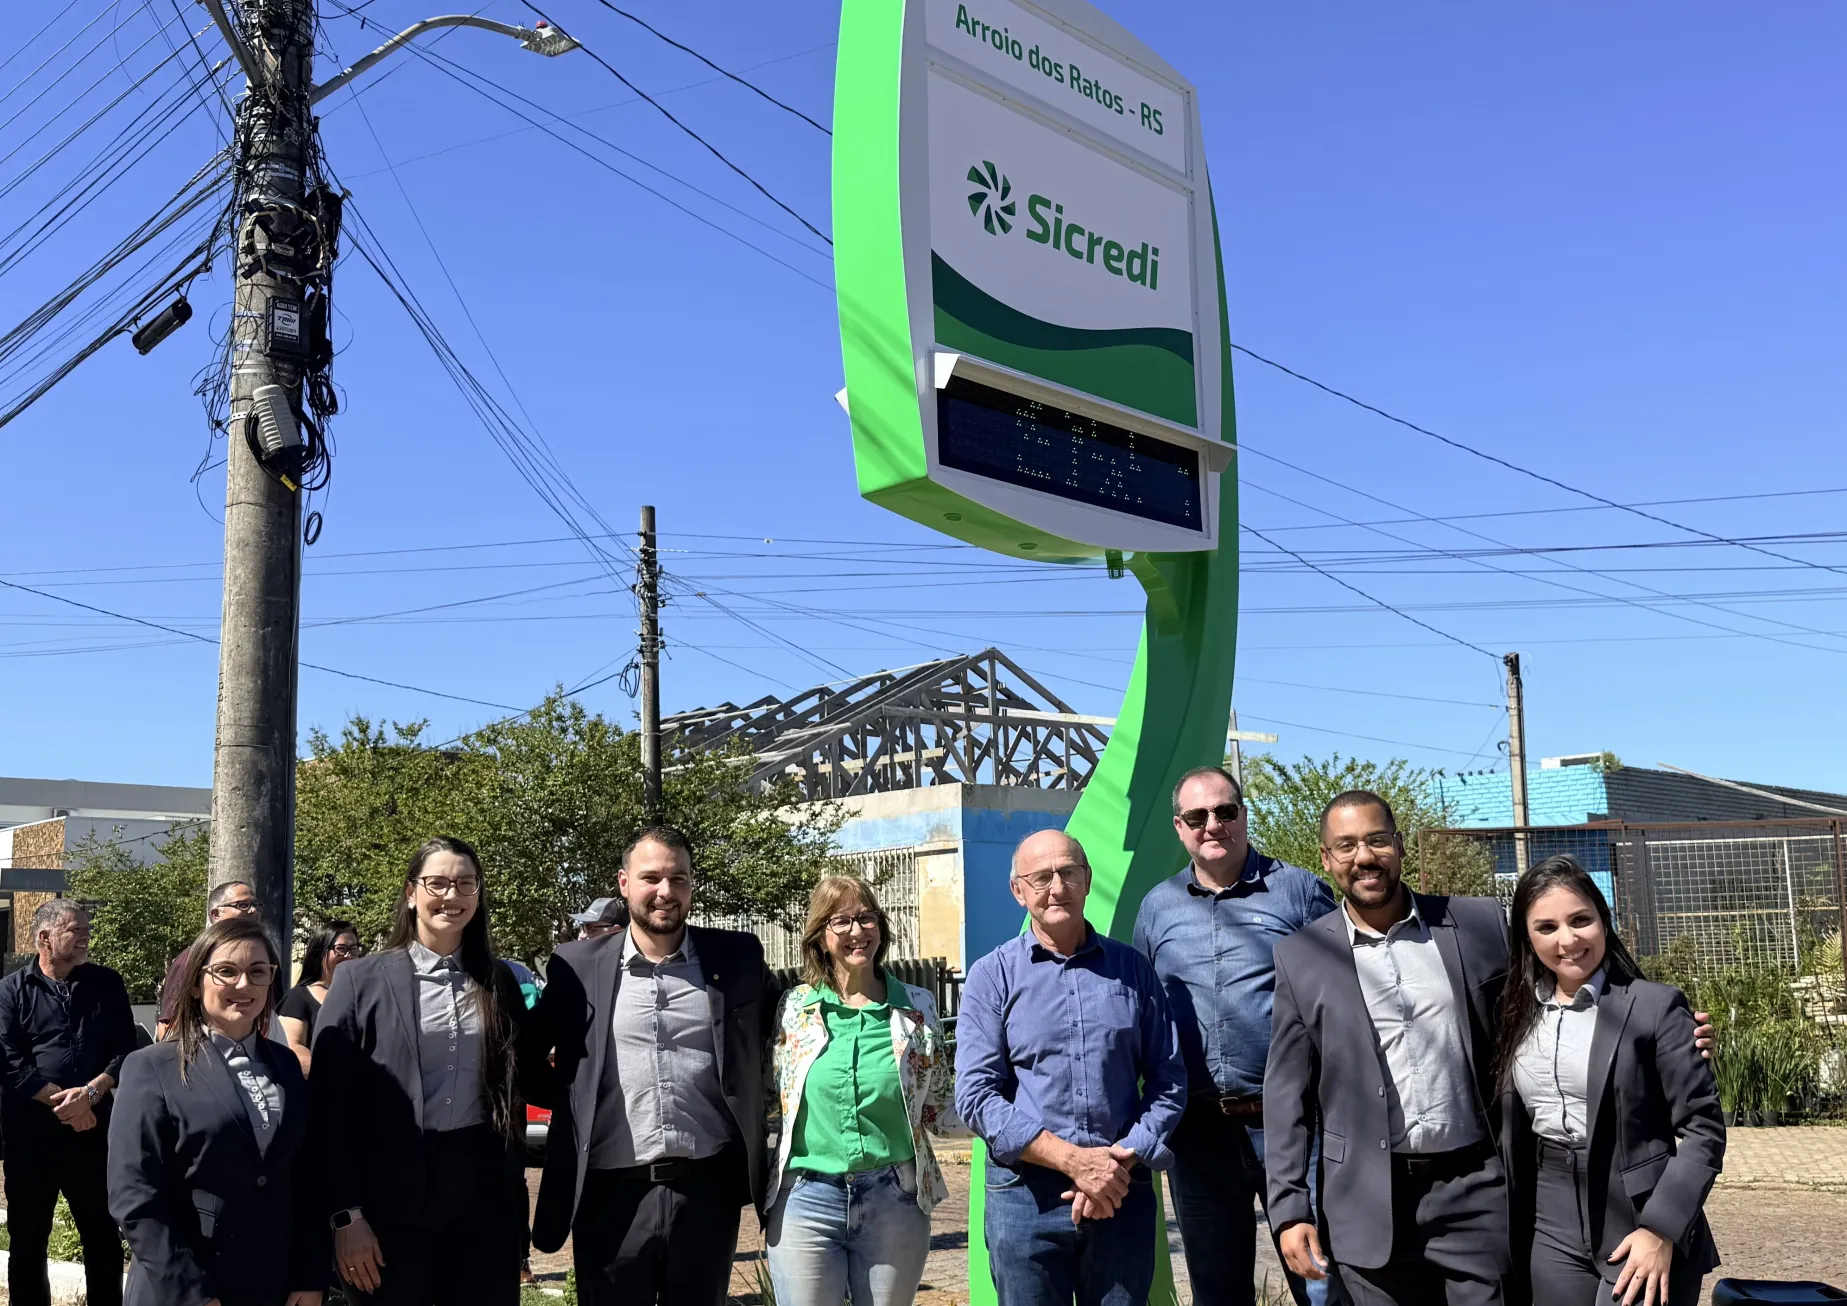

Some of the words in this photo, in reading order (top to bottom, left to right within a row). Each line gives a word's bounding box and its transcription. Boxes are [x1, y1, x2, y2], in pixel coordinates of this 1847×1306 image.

[955, 3, 1023, 62] Arroio
[1028, 44, 1065, 84] dos
[1068, 63, 1124, 116] Ratos
[1140, 101, 1164, 136] RS
[1025, 193, 1160, 291] Sicredi
